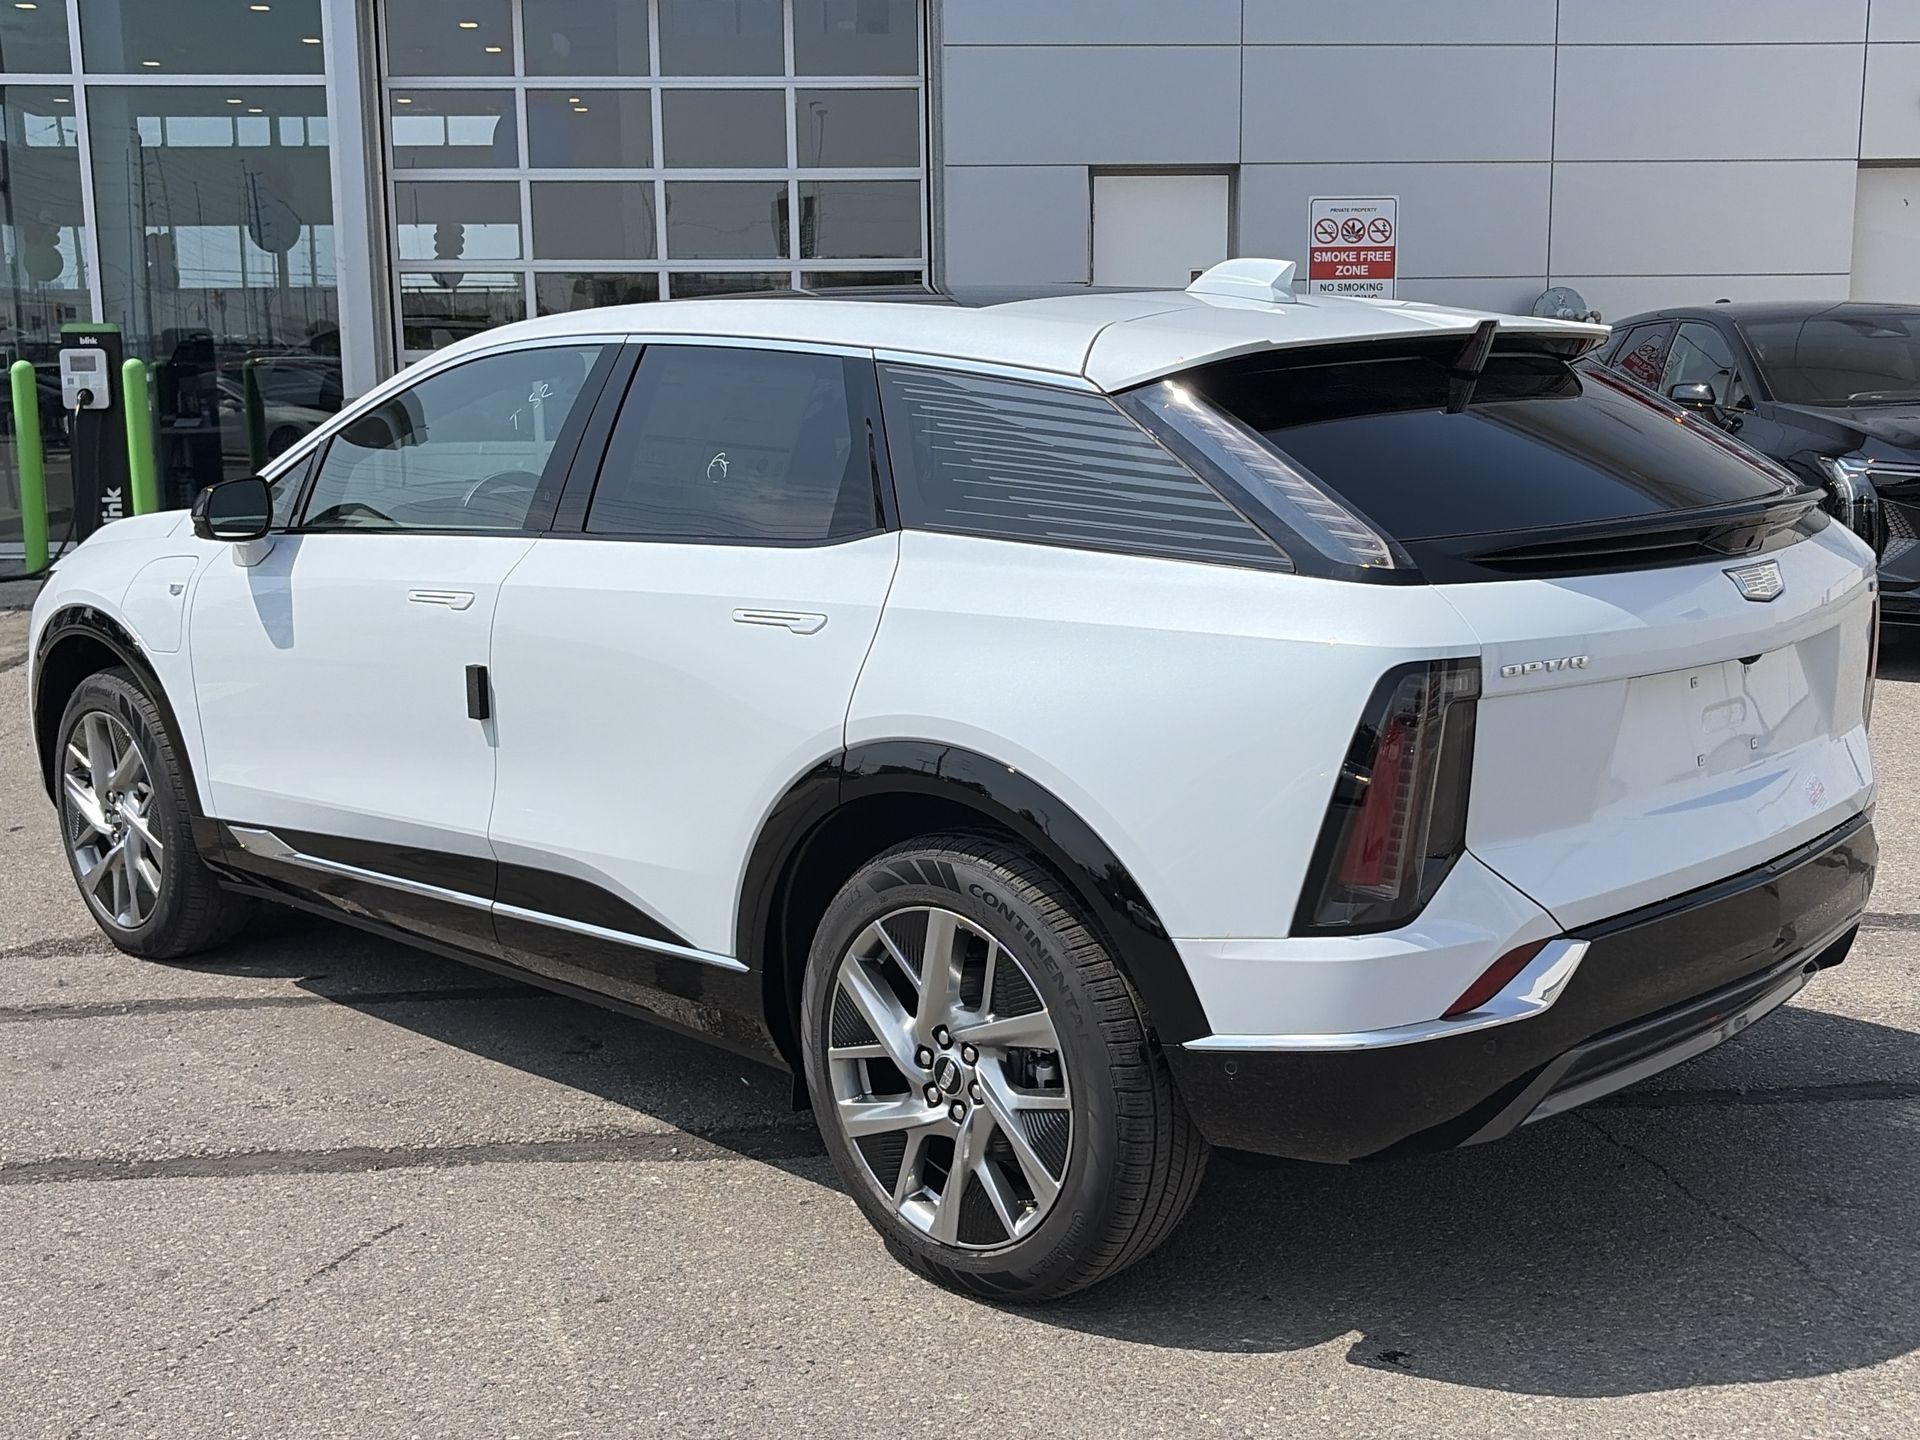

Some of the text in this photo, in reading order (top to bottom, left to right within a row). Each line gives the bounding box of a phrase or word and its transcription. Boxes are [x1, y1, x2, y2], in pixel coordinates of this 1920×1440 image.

[1313, 251, 1392, 262] SMOKE FREE
[1335, 265, 1369, 276] ZONE
[1320, 282, 1384, 292] NO SMOKING
[79, 336, 98, 344] blink
[101, 486, 123, 523] ink
[1501, 655, 1589, 678] OPTIQ
[968, 883, 1091, 1042] CONTINENTAL
